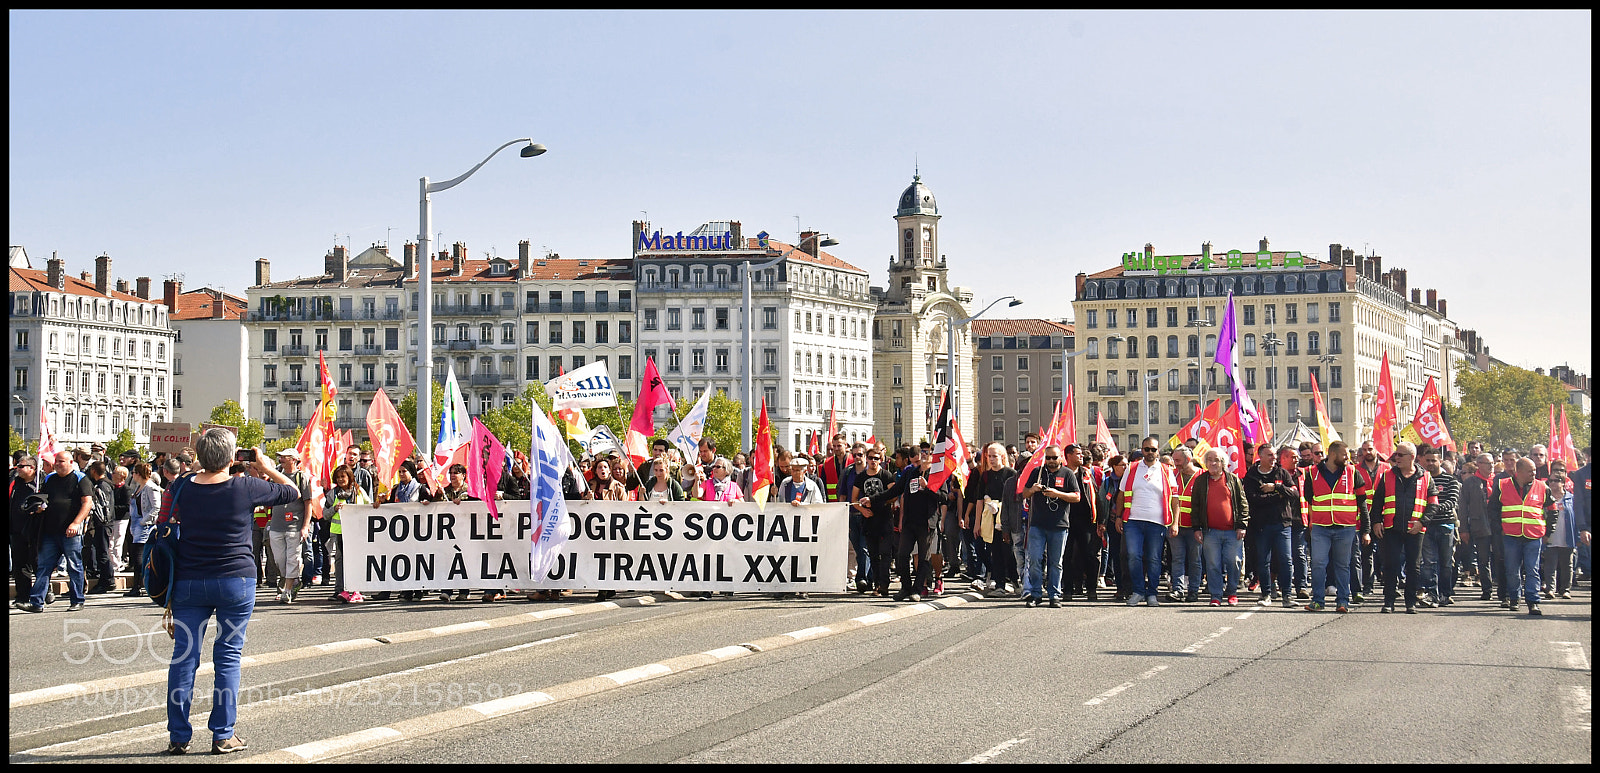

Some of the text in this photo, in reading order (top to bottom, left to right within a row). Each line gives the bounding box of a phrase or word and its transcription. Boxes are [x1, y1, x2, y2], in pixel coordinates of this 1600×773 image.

[638, 230, 732, 250] Matmut
[1123, 251, 1184, 275] liligo
[367, 504, 819, 542] POUR LE POGRÈS SOCIAL!
[366, 545, 818, 582] NON À LA OI TRAVAIL XXL!
